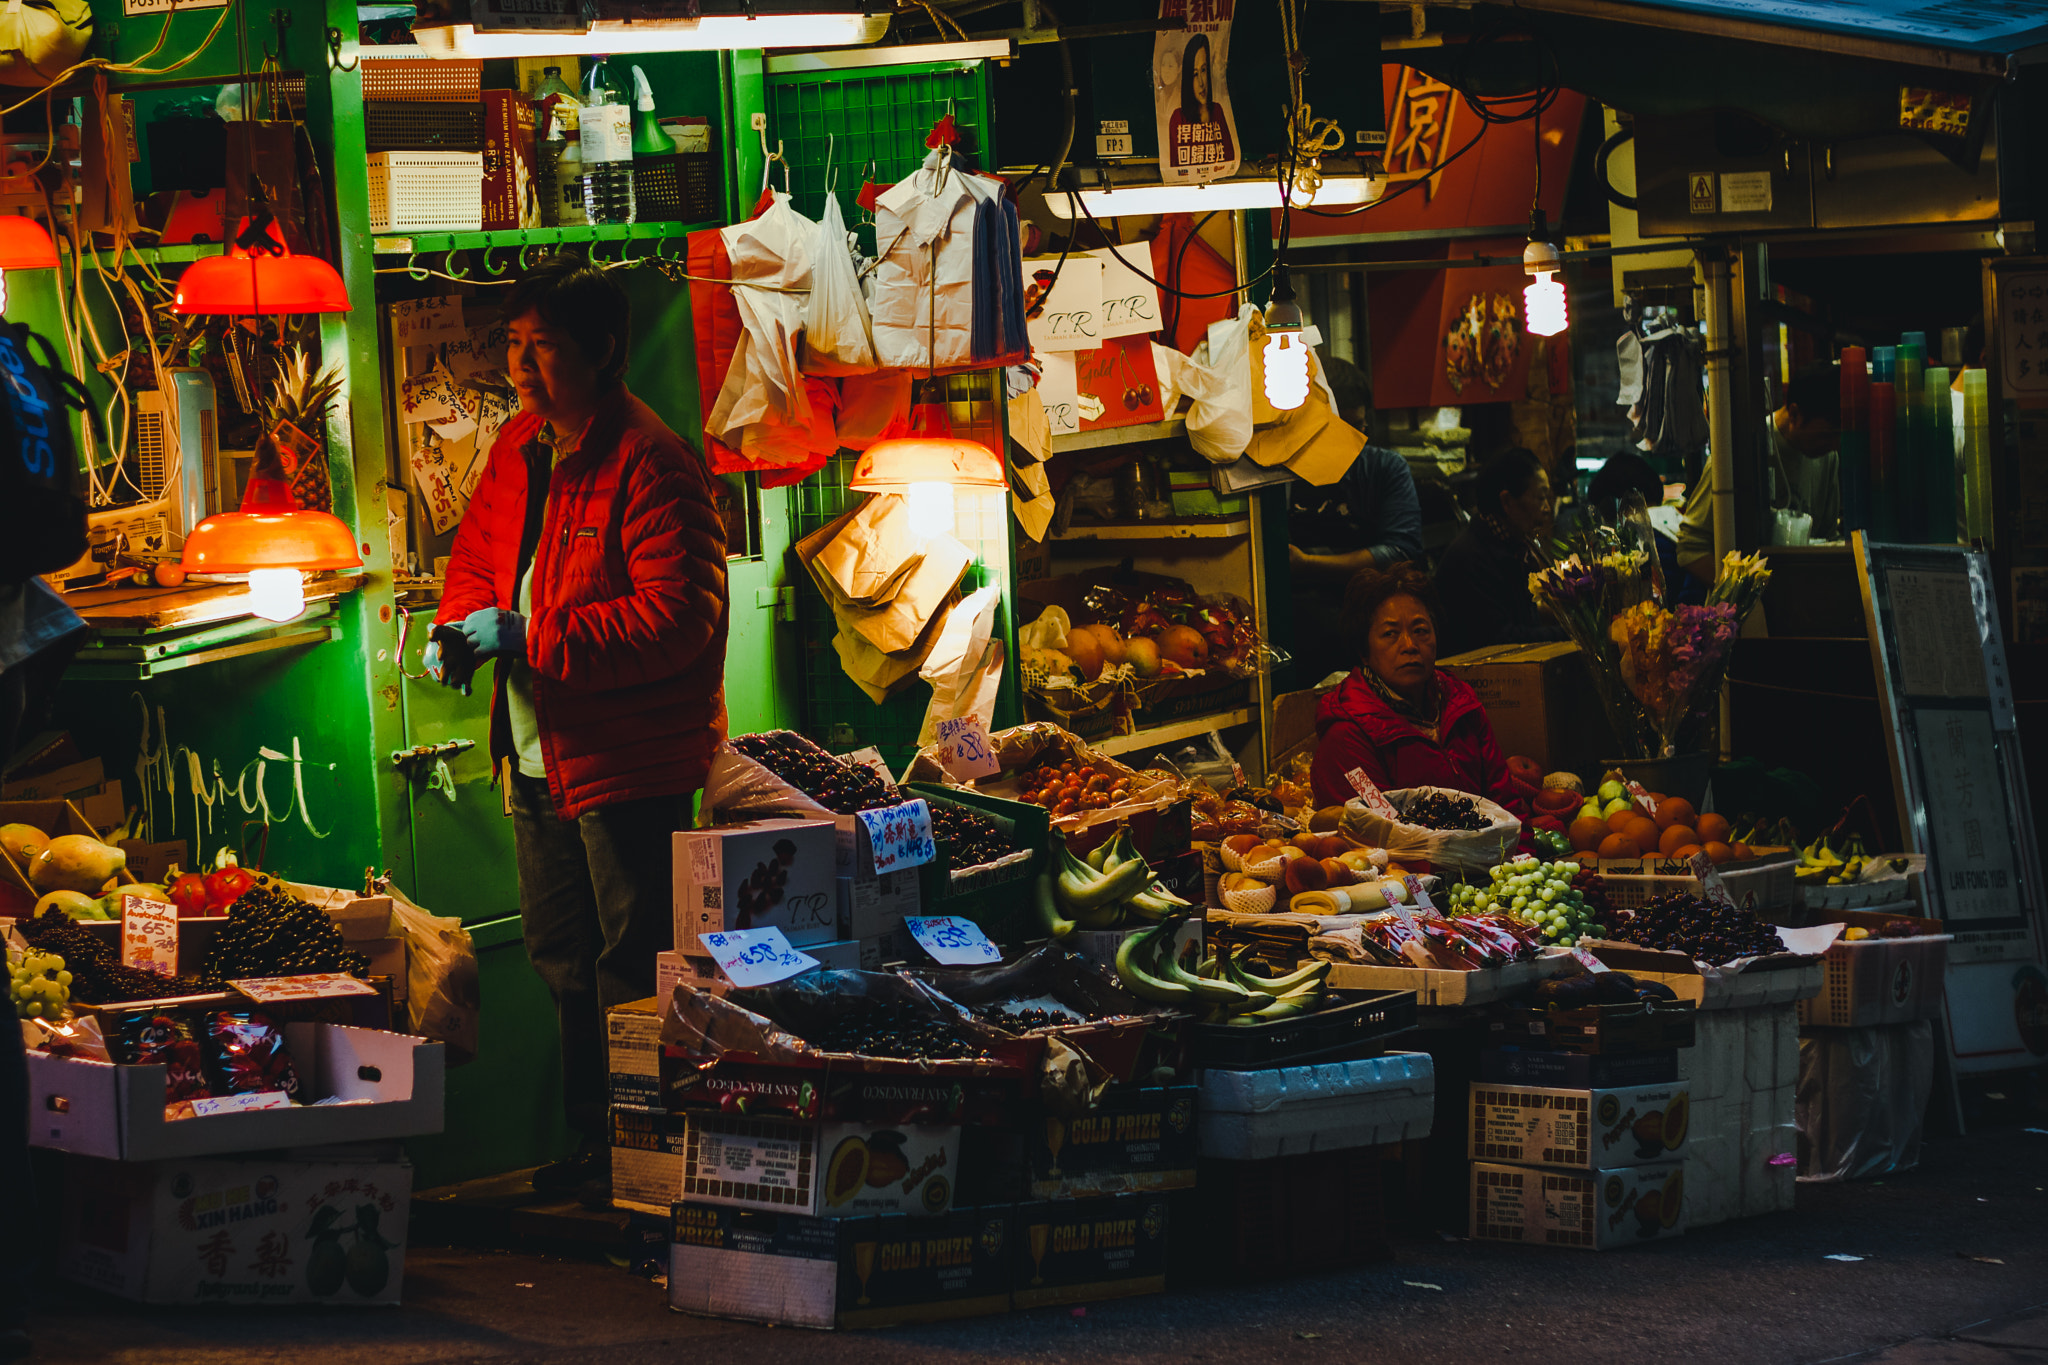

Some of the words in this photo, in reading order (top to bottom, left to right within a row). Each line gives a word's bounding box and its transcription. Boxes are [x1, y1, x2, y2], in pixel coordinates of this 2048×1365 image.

[503, 132, 511, 148] NEW
[1950, 872, 1966, 890] LAN
[1967, 870, 1988, 889] FONG
[1989, 870, 2008, 888] YUEN
[773, 1083, 798, 1096] SAN
[615, 1113, 652, 1131] GOLD
[1071, 1116, 1111, 1145] GOLD
[1115, 1113, 1161, 1141] PRIZE
[615, 1130, 659, 1150] PRIZE
[1126, 1142, 1161, 1153] WASHINGTON
[197, 1208, 226, 1230] XIN
[228, 1198, 278, 1223] HANG
[676, 1206, 717, 1228] GOLD
[675, 1224, 724, 1248] PRIZE
[1053, 1224, 1090, 1254] GOLD
[1093, 1219, 1136, 1249] PRIZE
[198, 1229, 295, 1279] 香梨
[881, 1241, 921, 1272] GOLD
[925, 1236, 973, 1266] PRIZE
